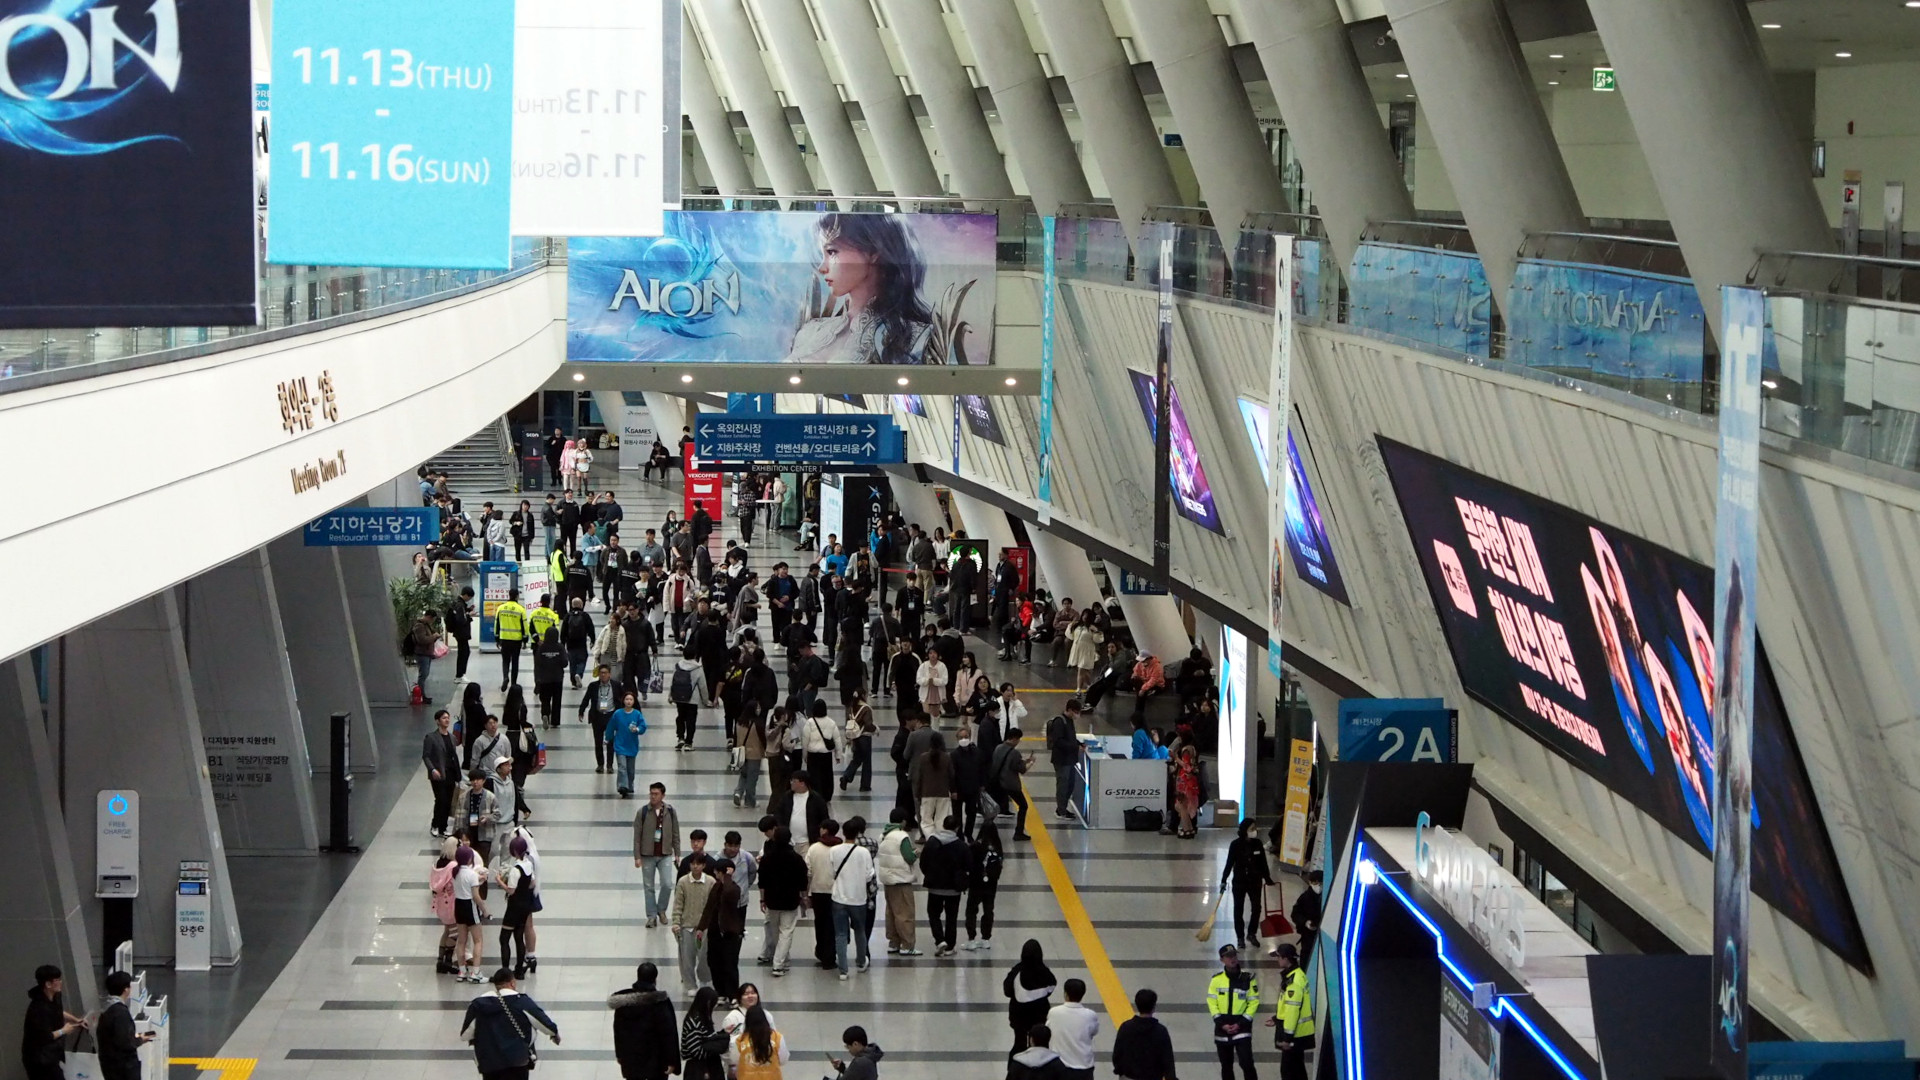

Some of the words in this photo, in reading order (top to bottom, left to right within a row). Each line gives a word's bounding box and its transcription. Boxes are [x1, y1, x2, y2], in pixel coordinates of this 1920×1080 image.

[293, 46, 492, 91] 11.13(THU)
[292, 142, 489, 187] 11.16(SUN)
[608, 268, 742, 319] AION
[717, 423, 761, 434] 옥외전시장
[717, 443, 761, 453] 지하주차장
[775, 442, 860, 454] 컨벤션홀/오디토리움
[752, 464, 789, 472] EXHIBITION
[290, 462, 320, 496] Meeting
[328, 516, 423, 533] 지하식당가
[328, 534, 368, 542] Restaurant
[1487, 585, 1553, 681] 하나의
[208, 736, 244, 745] 디지털무역
[246, 736, 276, 745] 지원센터
[208, 756, 224, 766] B1
[1137, 788, 1161, 796] 2025
